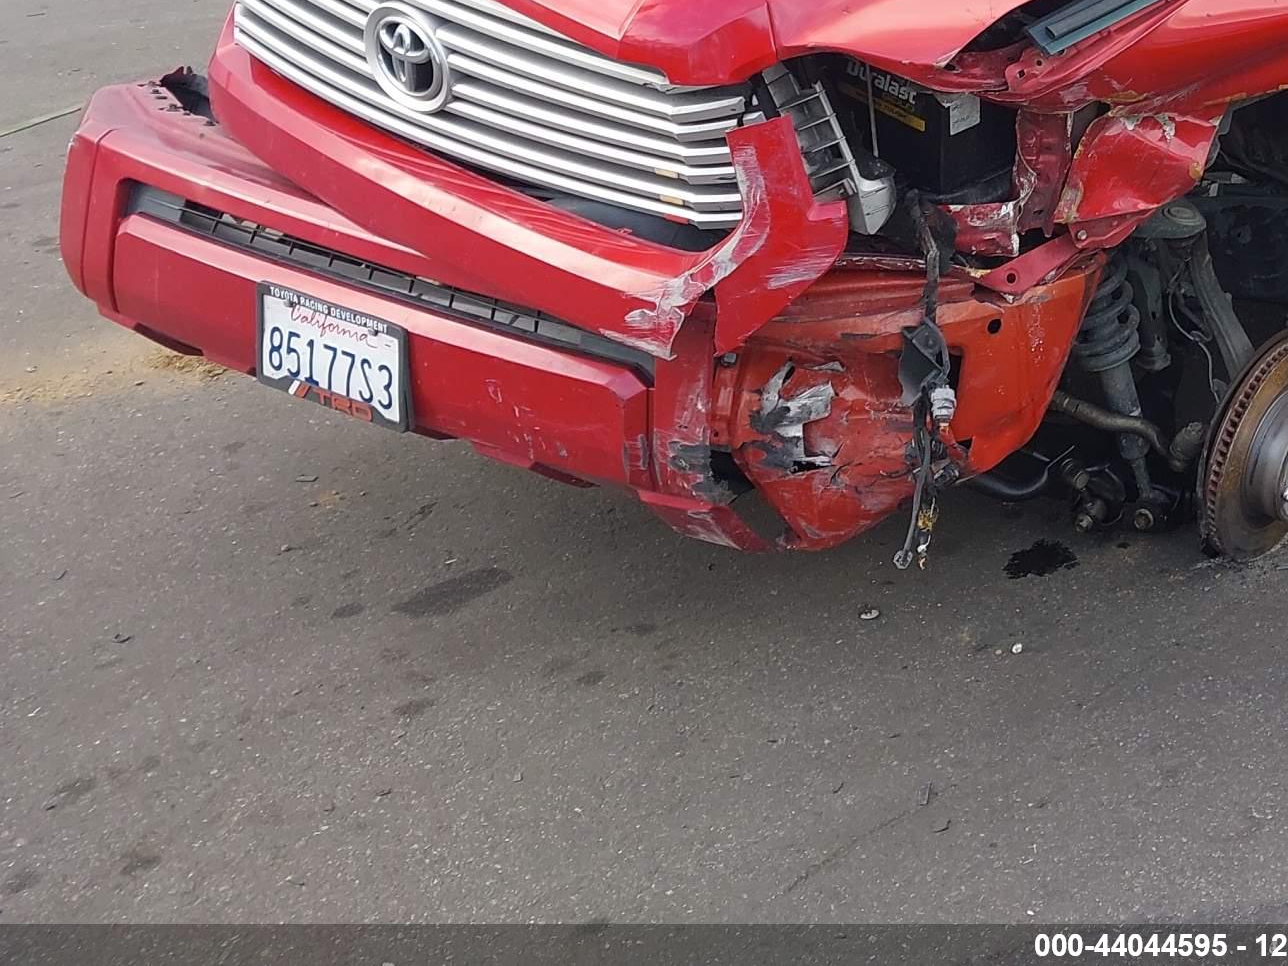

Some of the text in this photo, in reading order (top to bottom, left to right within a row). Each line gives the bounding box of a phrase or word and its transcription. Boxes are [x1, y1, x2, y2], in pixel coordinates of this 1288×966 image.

[269, 286, 388, 334] TOYOTA RACING DEVELOPMENT
[268, 326, 393, 410] 85177S3
[312, 386, 373, 422] TRD
